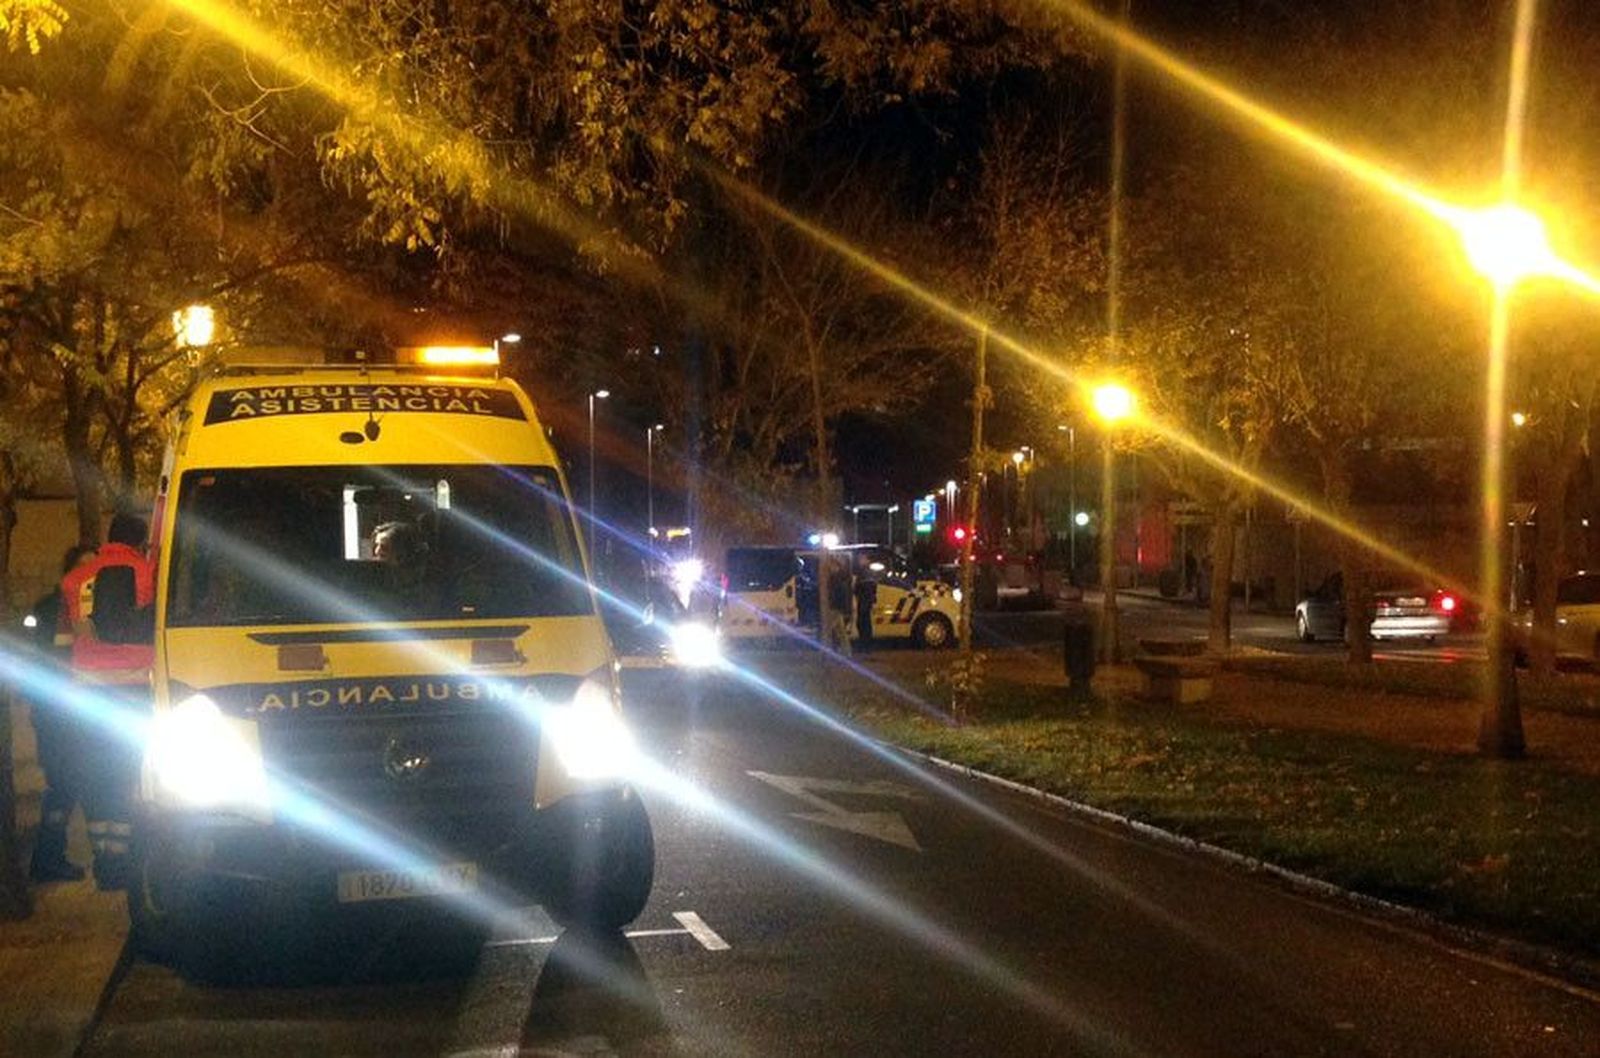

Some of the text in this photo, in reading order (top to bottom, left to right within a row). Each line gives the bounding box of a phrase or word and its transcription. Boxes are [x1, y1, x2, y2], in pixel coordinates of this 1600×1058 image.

[230, 385, 490, 401] AMBULANCIA
[230, 397, 492, 418] ASISTENCIAL
[918, 501, 931, 522] P
